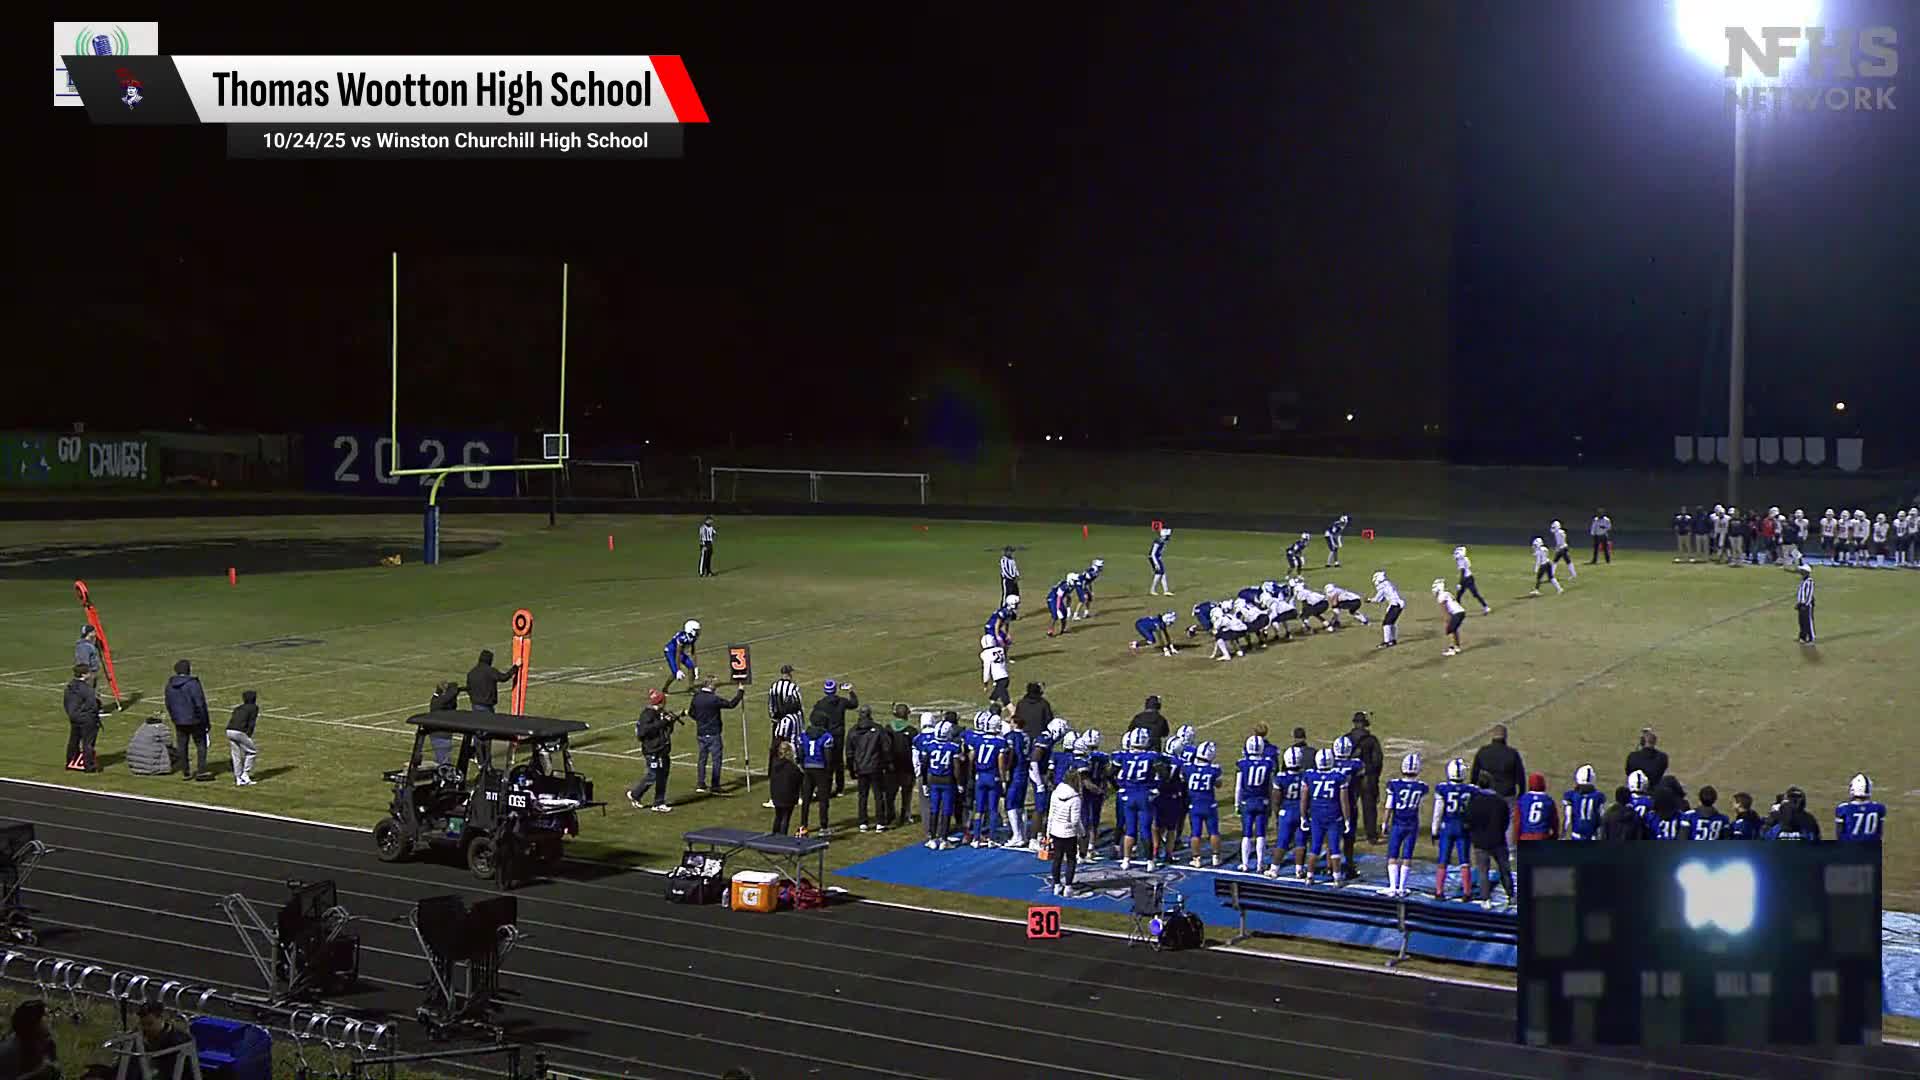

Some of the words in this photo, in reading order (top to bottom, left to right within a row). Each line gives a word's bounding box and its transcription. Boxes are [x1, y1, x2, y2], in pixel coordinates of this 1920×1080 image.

[58, 436, 81, 462] GO
[334, 436, 490, 488] 2026
[731, 648, 747, 671] 3
[930, 750, 951, 769] 24
[977, 743, 995, 764] 17
[1126, 760, 1149, 781] 72
[1247, 765, 1267, 786] 10
[1188, 773, 1213, 791] 63
[1312, 780, 1335, 800] 75
[1395, 789, 1422, 810] 30
[1580, 798, 1594, 820] 11
[1528, 801, 1542, 823] 6
[1852, 812, 1878, 835] 70
[1030, 910, 1059, 935] 30
